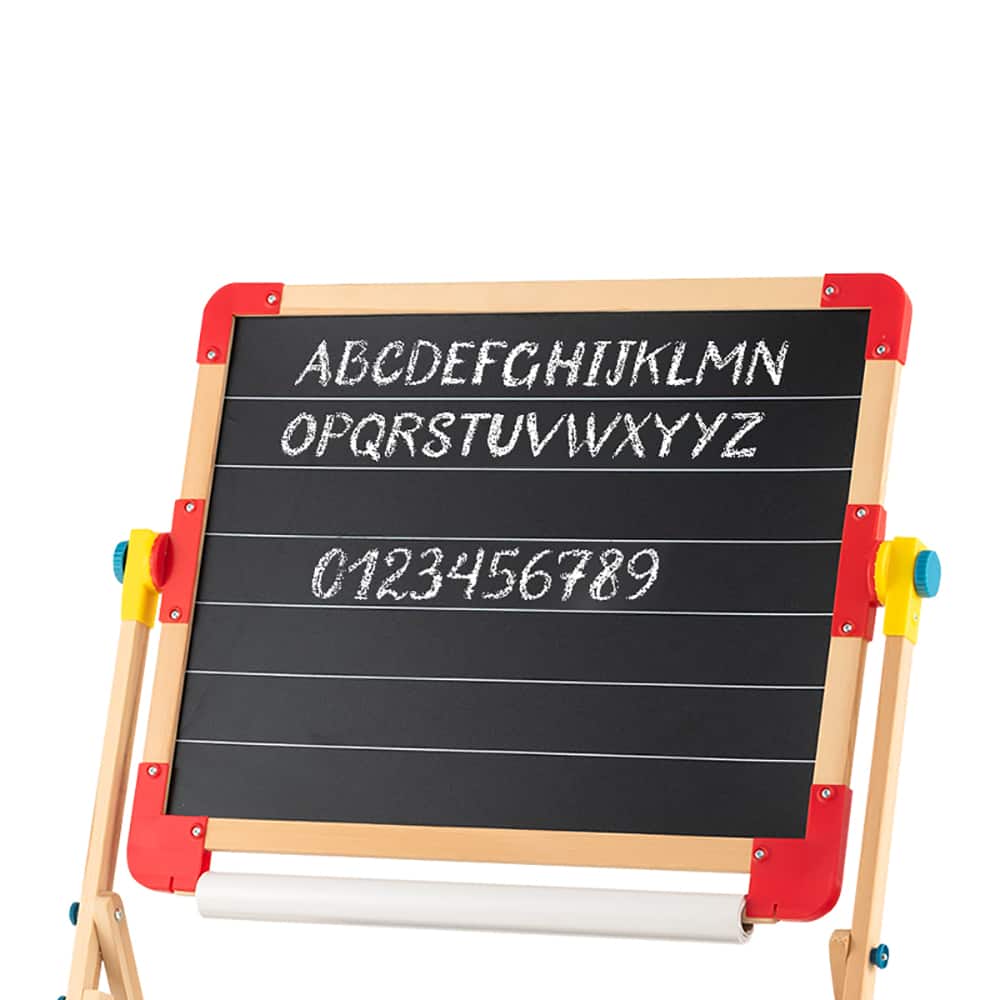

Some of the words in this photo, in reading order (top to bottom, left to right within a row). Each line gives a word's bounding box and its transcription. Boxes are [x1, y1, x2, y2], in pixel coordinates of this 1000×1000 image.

[295, 339, 789, 390] ABCDEFGHIJKLMN
[280, 411, 767, 462] OPQRSTUVWXYYZ
[311, 547, 661, 601] 0123456789
